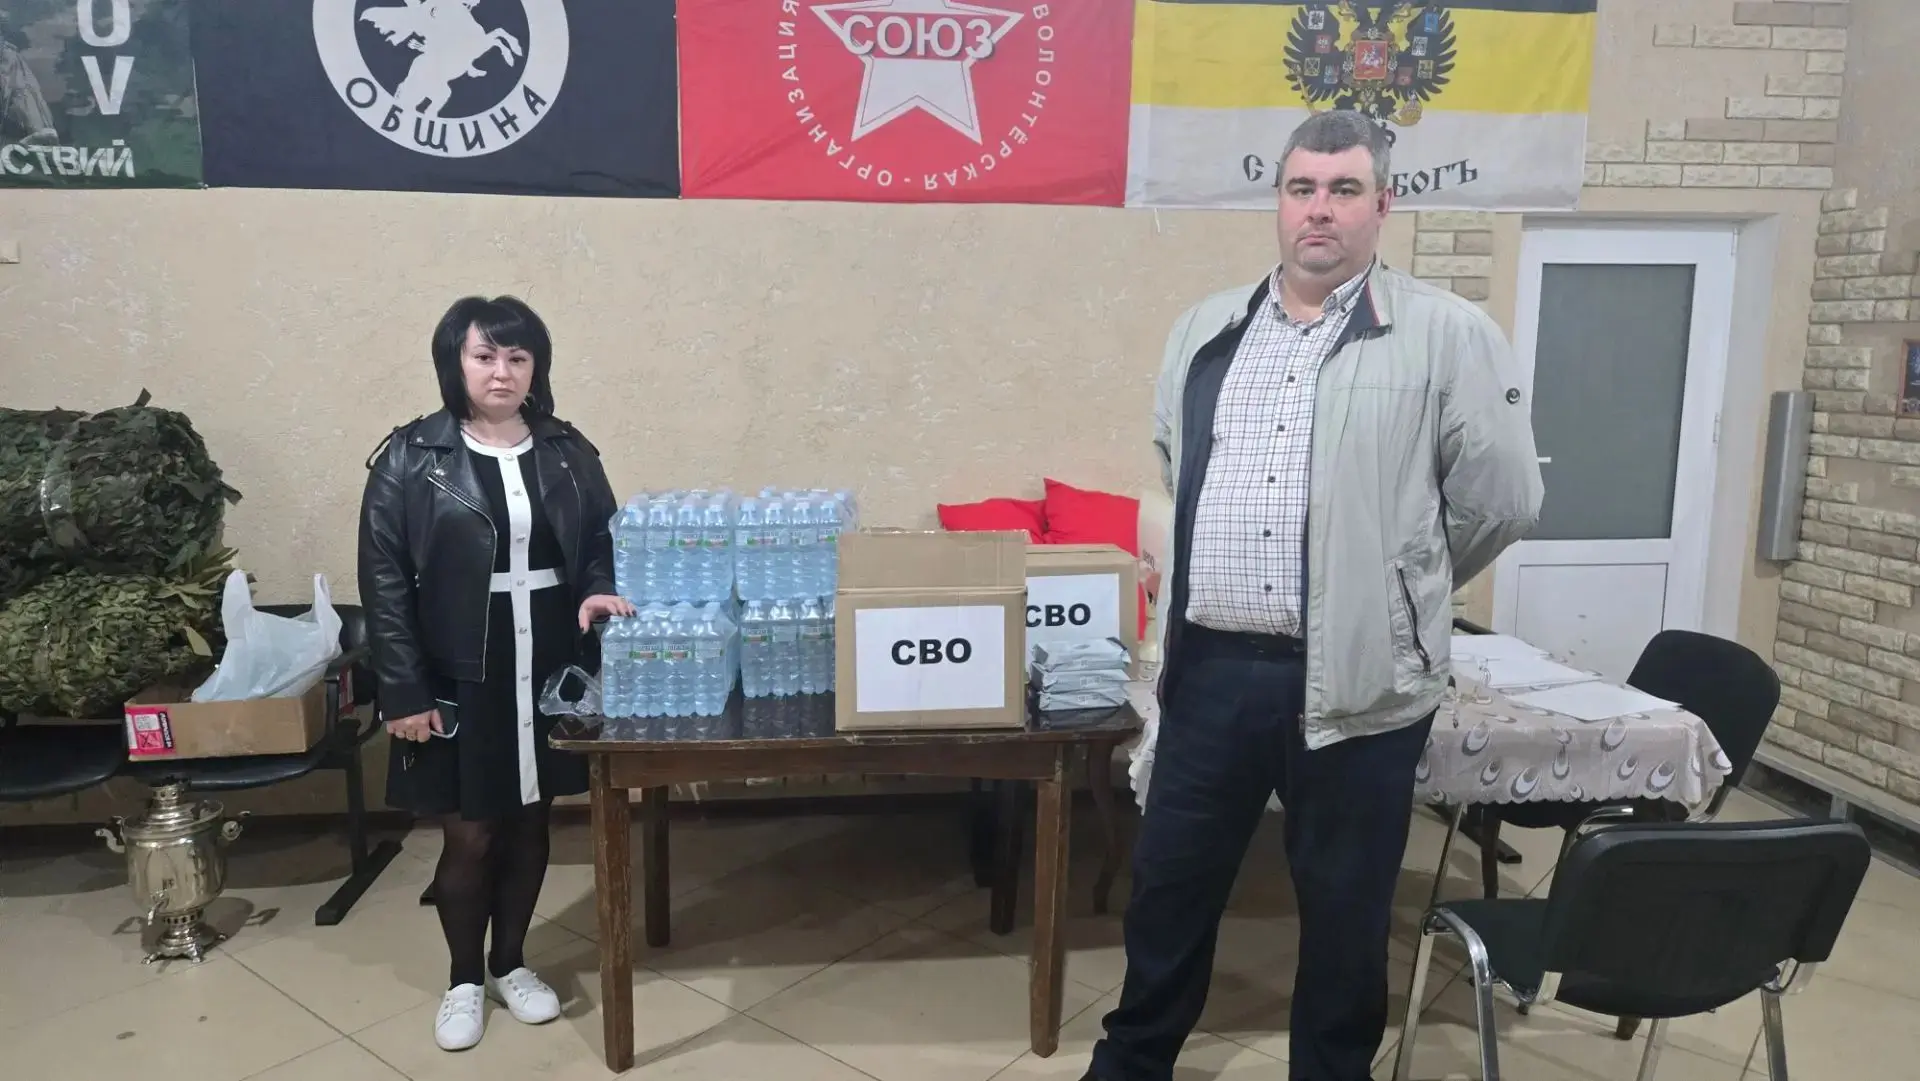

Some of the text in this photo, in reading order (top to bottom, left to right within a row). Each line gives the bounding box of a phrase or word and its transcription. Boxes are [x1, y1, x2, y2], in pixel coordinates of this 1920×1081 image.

[842, 14, 994, 60] СОЮЗ
[345, 77, 547, 153] ОБЩИНА
[777, 0, 893, 187] ОРГАНИЗАЦИЯ
[924, 3, 1056, 191] ВОЛОНТЁРСКАЯ
[1025, 602, 1092, 628] СВО
[891, 637, 973, 666] СВО
